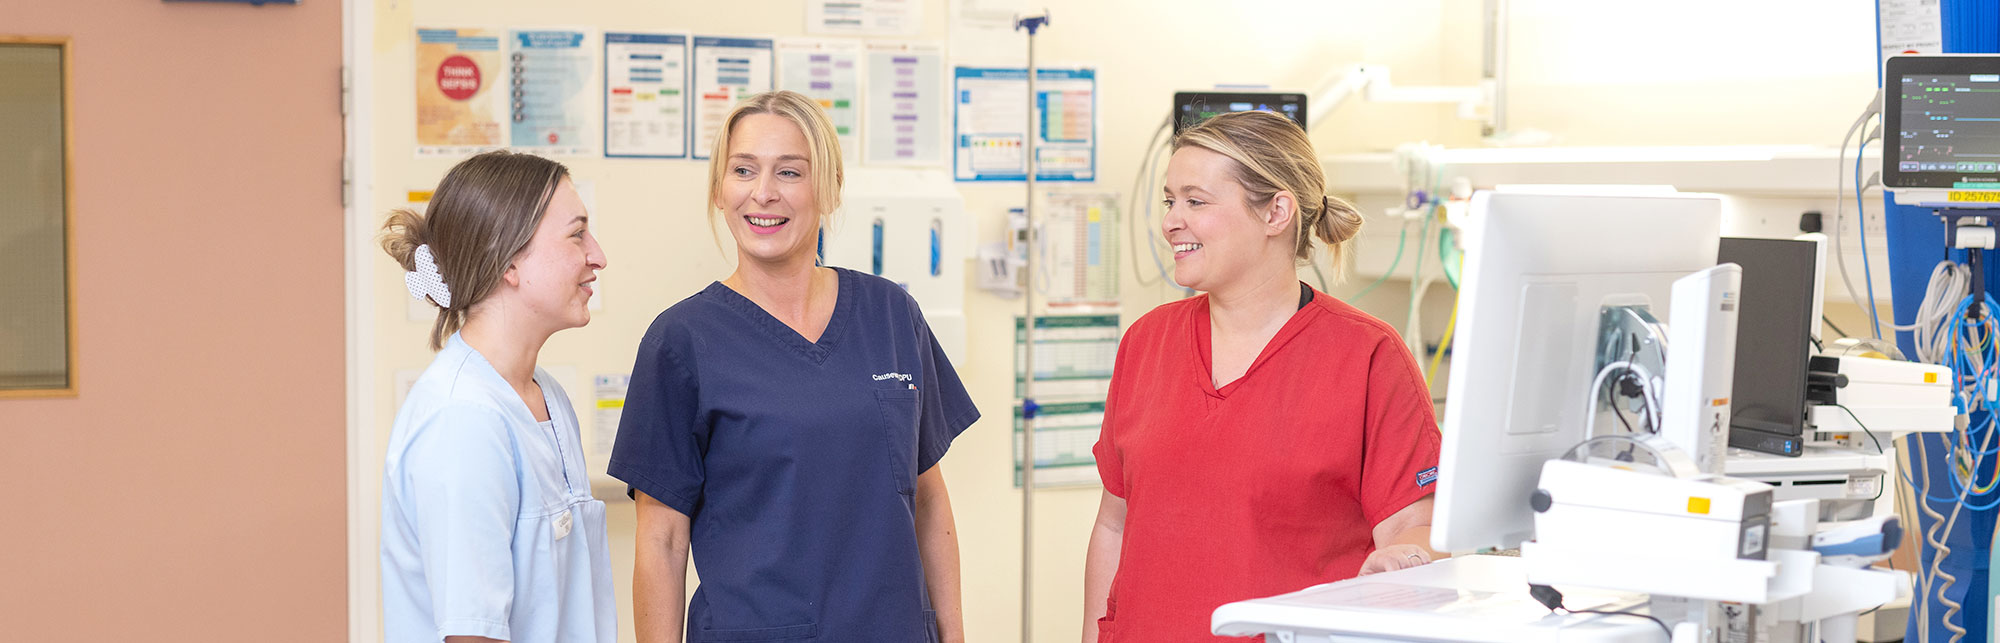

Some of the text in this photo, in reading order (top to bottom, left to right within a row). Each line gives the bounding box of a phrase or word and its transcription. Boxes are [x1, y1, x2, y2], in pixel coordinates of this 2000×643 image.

[444, 66, 474, 76] THINK
[442, 79, 477, 90] SEPSIS
[1950, 191, 1961, 201] ID
